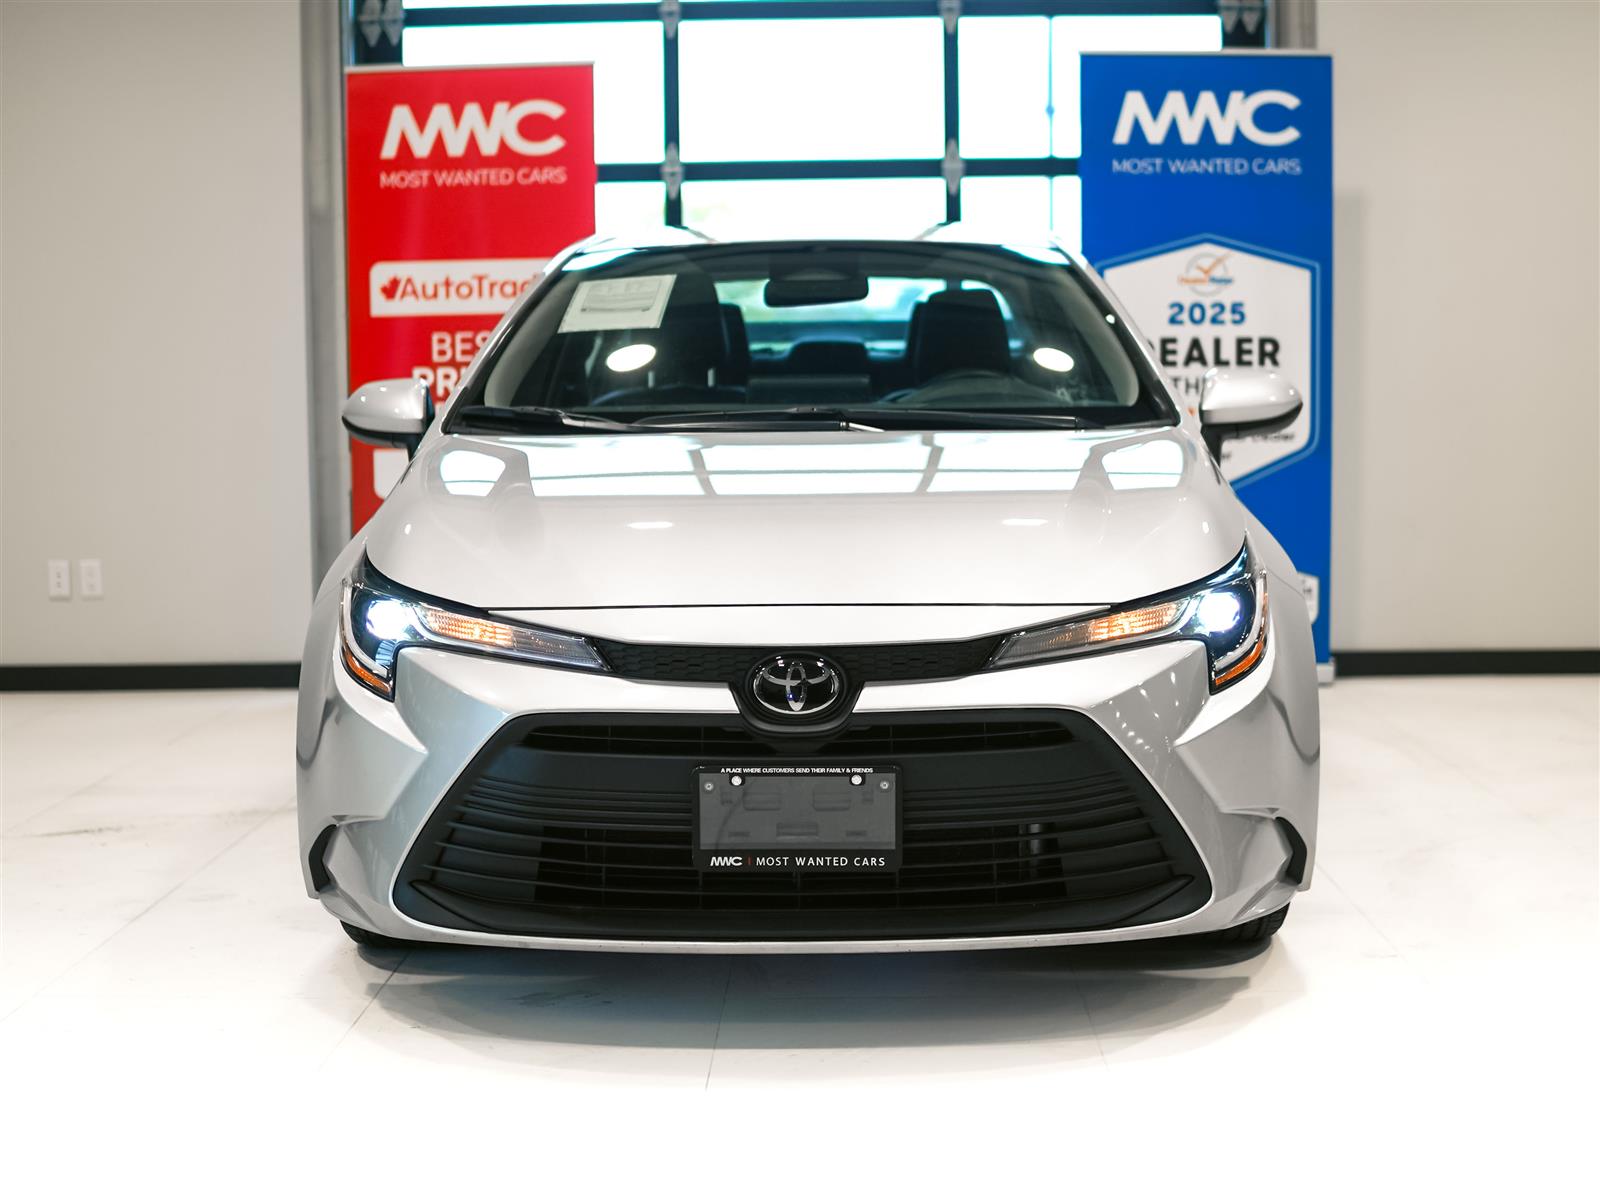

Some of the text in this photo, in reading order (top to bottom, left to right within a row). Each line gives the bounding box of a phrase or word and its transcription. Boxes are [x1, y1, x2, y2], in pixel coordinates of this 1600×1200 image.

[380, 98, 566, 160] MWC
[1112, 89, 1301, 147] MWC
[379, 166, 567, 189] MOST WANTED CARS
[1112, 157, 1302, 176] MOST WANTED CARS
[1168, 301, 1247, 325] 2025
[1147, 336, 1281, 367] EALER
[1171, 376, 1201, 395] TH
[710, 856, 886, 867] MWC MOST WANTED CARS
